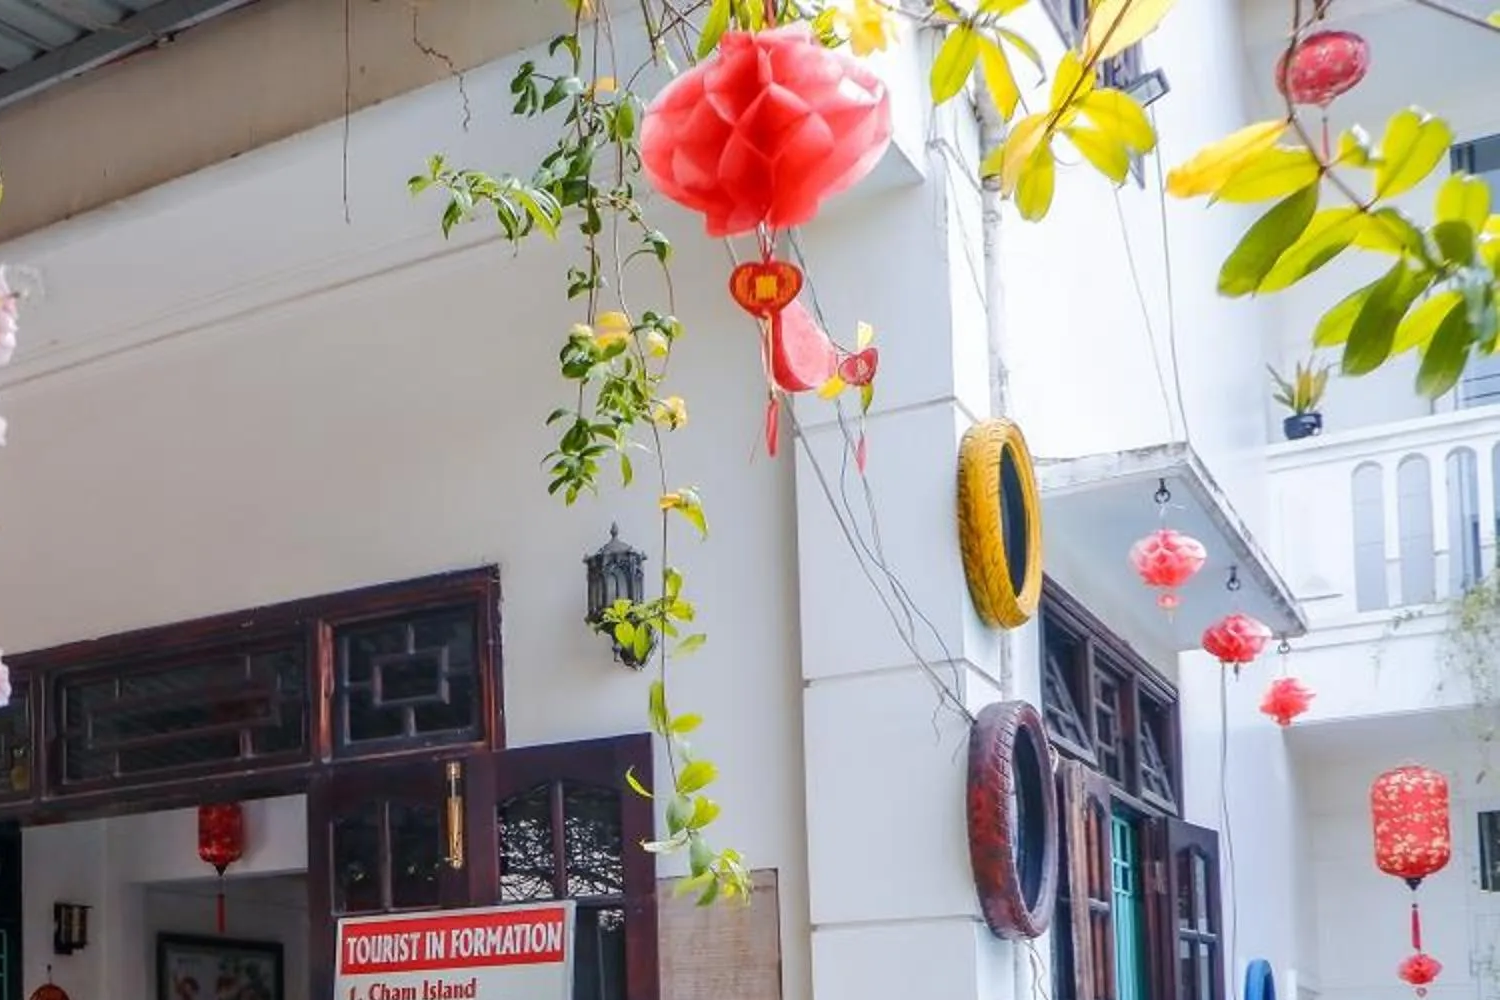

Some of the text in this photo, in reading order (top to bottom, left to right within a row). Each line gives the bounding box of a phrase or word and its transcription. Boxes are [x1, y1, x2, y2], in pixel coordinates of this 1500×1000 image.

[347, 921, 563, 965] TOURIST IN FORMATION
[423, 978, 477, 1000] Island
